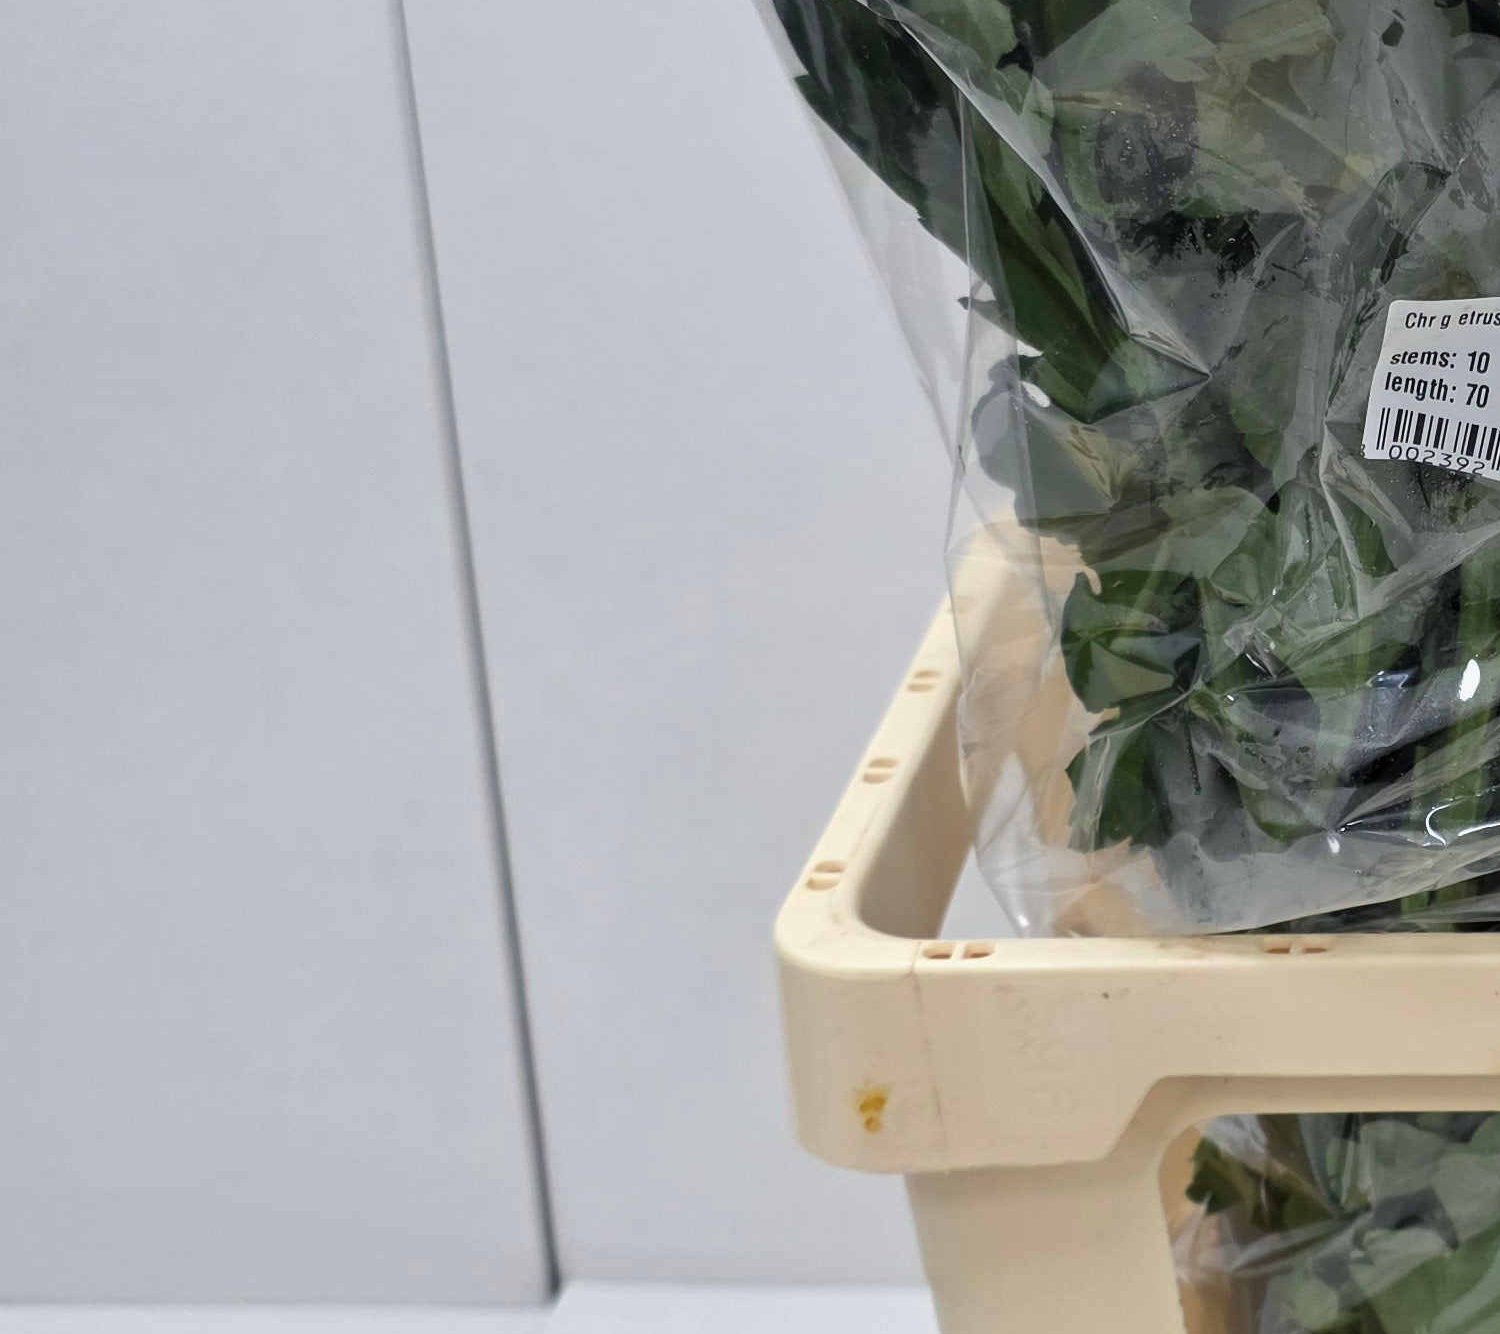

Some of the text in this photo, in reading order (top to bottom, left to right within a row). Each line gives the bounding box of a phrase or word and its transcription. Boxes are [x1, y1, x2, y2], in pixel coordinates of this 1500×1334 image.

[1404, 311, 1434, 330] Chr
[1439, 314, 1451, 331] g
[1389, 350, 1491, 374] stems: 10
[1384, 371, 1490, 409] length: 70
